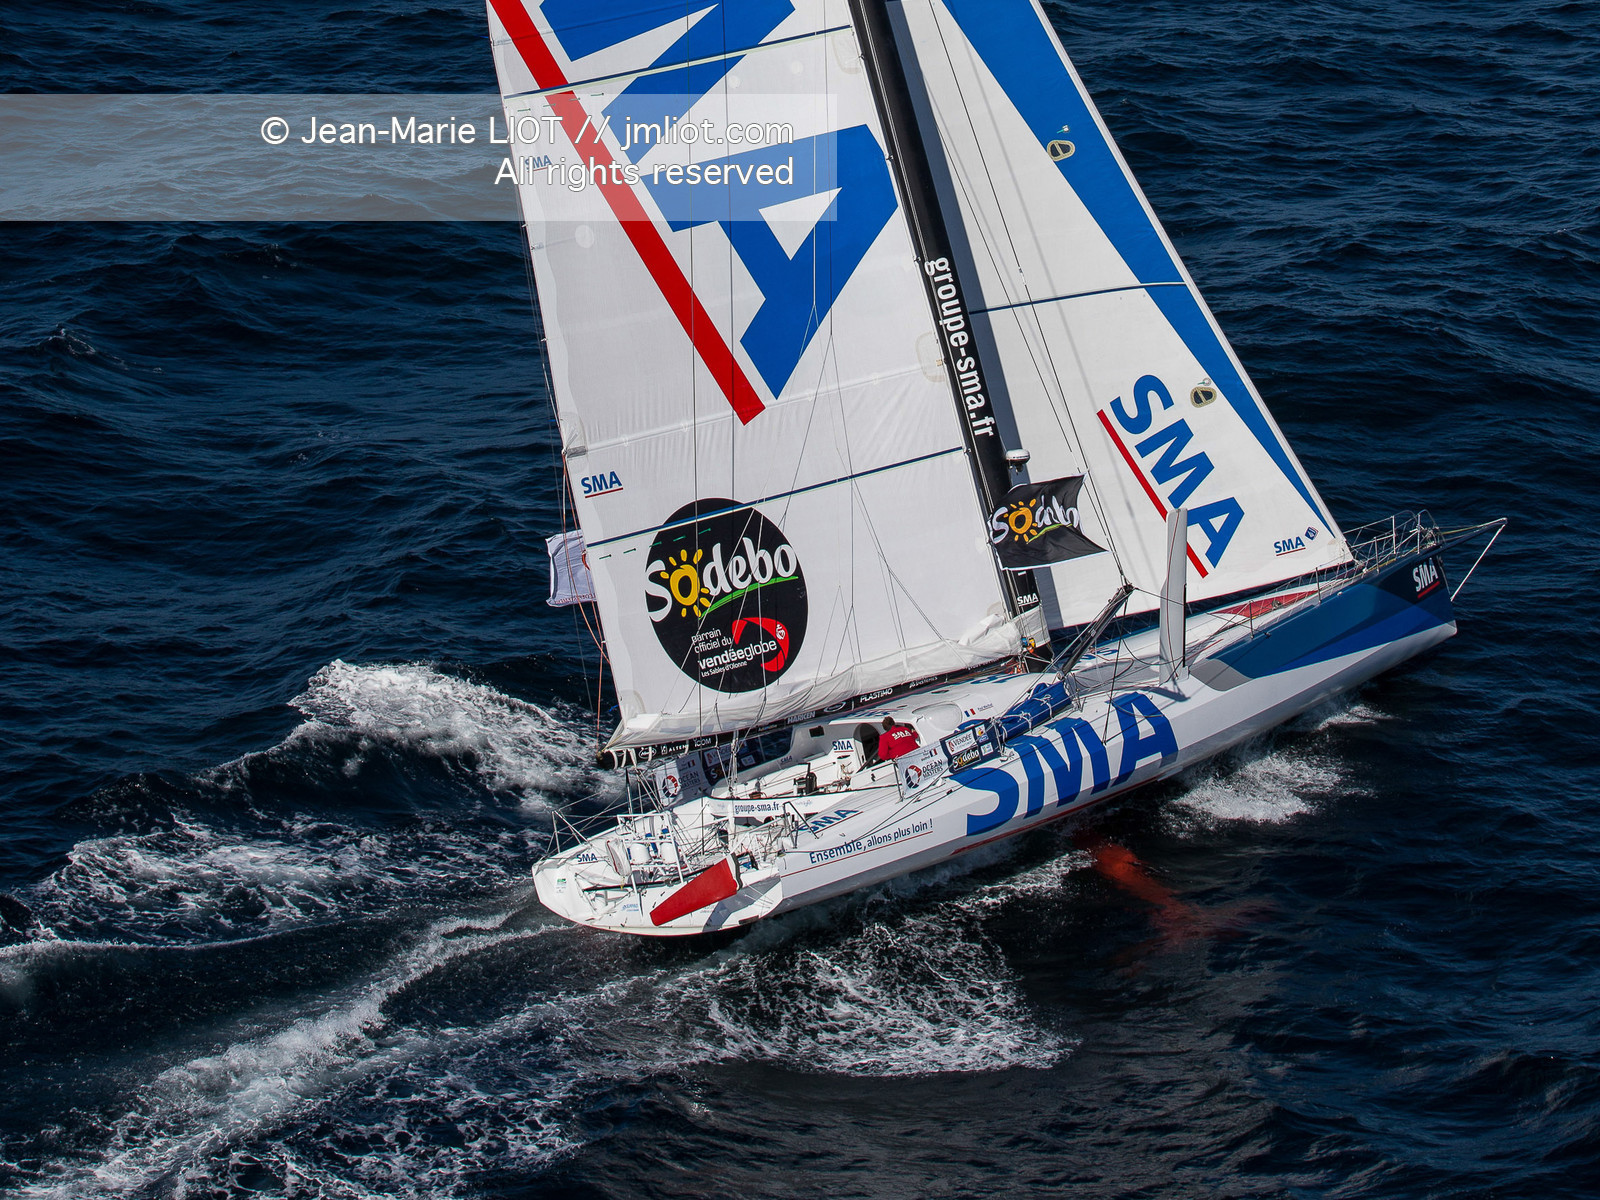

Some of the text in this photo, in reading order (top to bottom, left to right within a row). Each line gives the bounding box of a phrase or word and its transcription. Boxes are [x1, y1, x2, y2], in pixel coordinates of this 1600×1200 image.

[924, 256, 996, 437] groupe-sma.fr
[1109, 374, 1245, 569] SMA
[581, 470, 622, 494] SMA
[1273, 535, 1306, 553] SMA
[645, 536, 798, 623] Sodebo
[1412, 557, 1439, 592] SMA
[1017, 592, 1039, 605] SMA
[691, 628, 721, 645] parrain
[694, 636, 733, 654] officiel du
[859, 687, 893, 703] PLASTIMO
[787, 711, 816, 725] HARKEN
[891, 730, 912, 740] SMA
[832, 740, 853, 751] SMA
[922, 759, 943, 773] OCEAN
[950, 691, 1179, 836] SMA
[734, 801, 780, 814] groupe-sma.fr
[797, 809, 859, 833] SMA
[867, 834, 892, 847] allons
[893, 827, 911, 841] plus
[912, 821, 928, 834] loin
[576, 853, 598, 863] SMA
